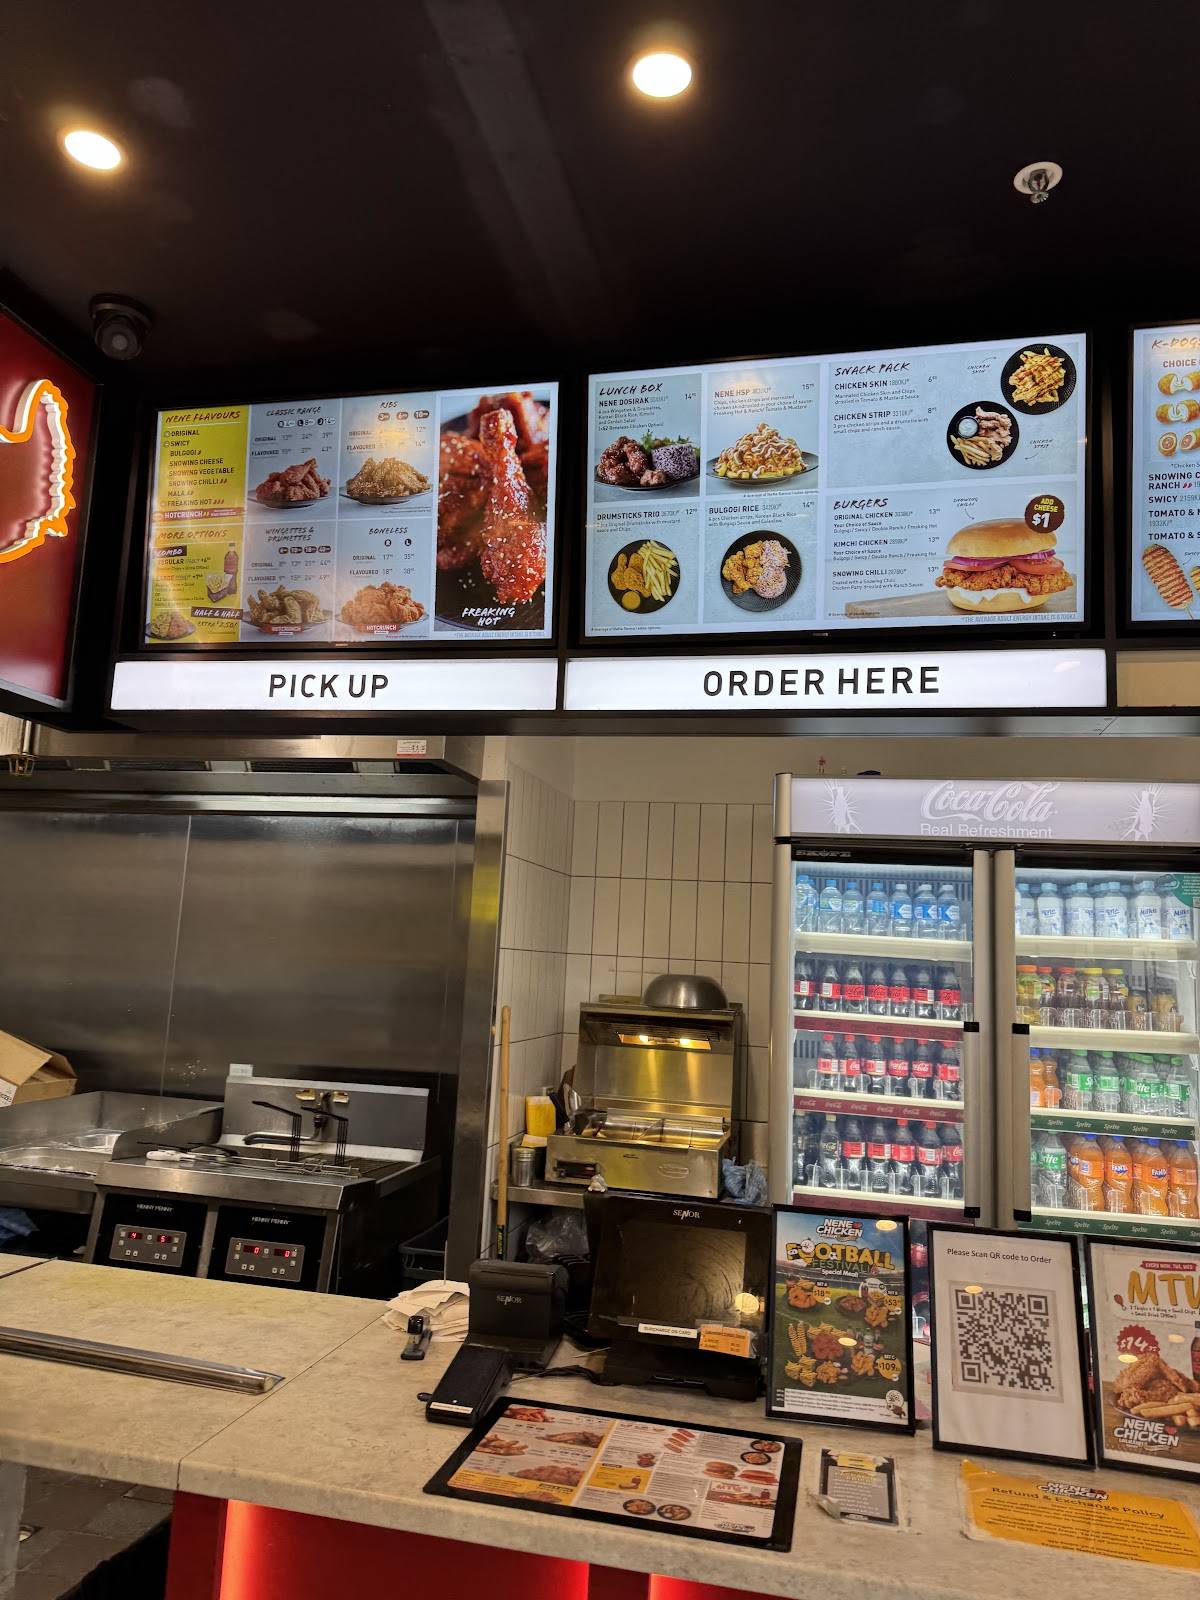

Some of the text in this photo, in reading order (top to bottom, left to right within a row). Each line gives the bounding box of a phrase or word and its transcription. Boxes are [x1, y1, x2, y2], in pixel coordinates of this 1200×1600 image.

[1163, 359, 1197, 368] CHOICE
[835, 362, 911, 376] SNACK PACK
[600, 383, 663, 396] LUNCH BOX
[834, 381, 868, 390] CHICKEN
[715, 390, 734, 398] NENE
[619, 397, 649, 406] DOSIRAK
[297, 407, 321, 415] RANGE
[834, 412, 867, 421] CHICKEN
[869, 411, 891, 419] STRIP
[166, 411, 240, 423] NENE FLAVOURS
[169, 469, 198, 477] SNOWING
[1148, 472, 1192, 481] SNOWING
[1148, 481, 1180, 490] RANCH
[833, 498, 888, 510] BURGERS
[1148, 495, 1178, 504] SWICY
[709, 506, 741, 514] BULGOGI
[743, 505, 759, 513] RICE
[1034, 504, 1059, 513] CHEESE
[1148, 509, 1185, 518] TOMATO
[164, 511, 203, 519] HOTCRUNCH
[597, 512, 642, 520] DRUMSTICKS
[865, 511, 893, 519] CHICKEN
[1032, 512, 1051, 528] $1
[160, 530, 228, 540] MORE OPTIONS
[265, 527, 307, 535] WINGETTES
[369, 527, 408, 535] BONELESS
[1148, 532, 1185, 541] TOMATO
[462, 607, 516, 617] FREAKING
[478, 617, 501, 626] HOT
[268, 674, 389, 698] PICK UP
[703, 666, 941, 698] ORDER HERE
[920, 823, 1054, 840] Real Refreshment
[136, 1203, 174, 1213] HENNY PENNY
[673, 1209, 700, 1220] SENOR
[251, 1216, 271, 1224] HENNY
[823, 1219, 853, 1229] NENE
[816, 1226, 863, 1237] CHICKEN
[786, 1239, 895, 1270] FOOTBALL
[947, 1248, 970, 1257] Please
[971, 1250, 988, 1258] Scan
[989, 1251, 1001, 1259] QR
[1002, 1253, 1020, 1261] code
[1030, 1255, 1052, 1264] Order
[821, 1268, 842, 1276] Special
[1124, 1418, 1165, 1433] NENE
[1114, 1428, 1179, 1447] CHICKEN
[1046, 1482, 1091, 1492] NENE
[1037, 1485, 1108, 1501] CHICKEN
[992, 1487, 1040, 1500] Refund
[1055, 1497, 1119, 1512] Exchange
[1123, 1506, 1165, 1520] Policy
